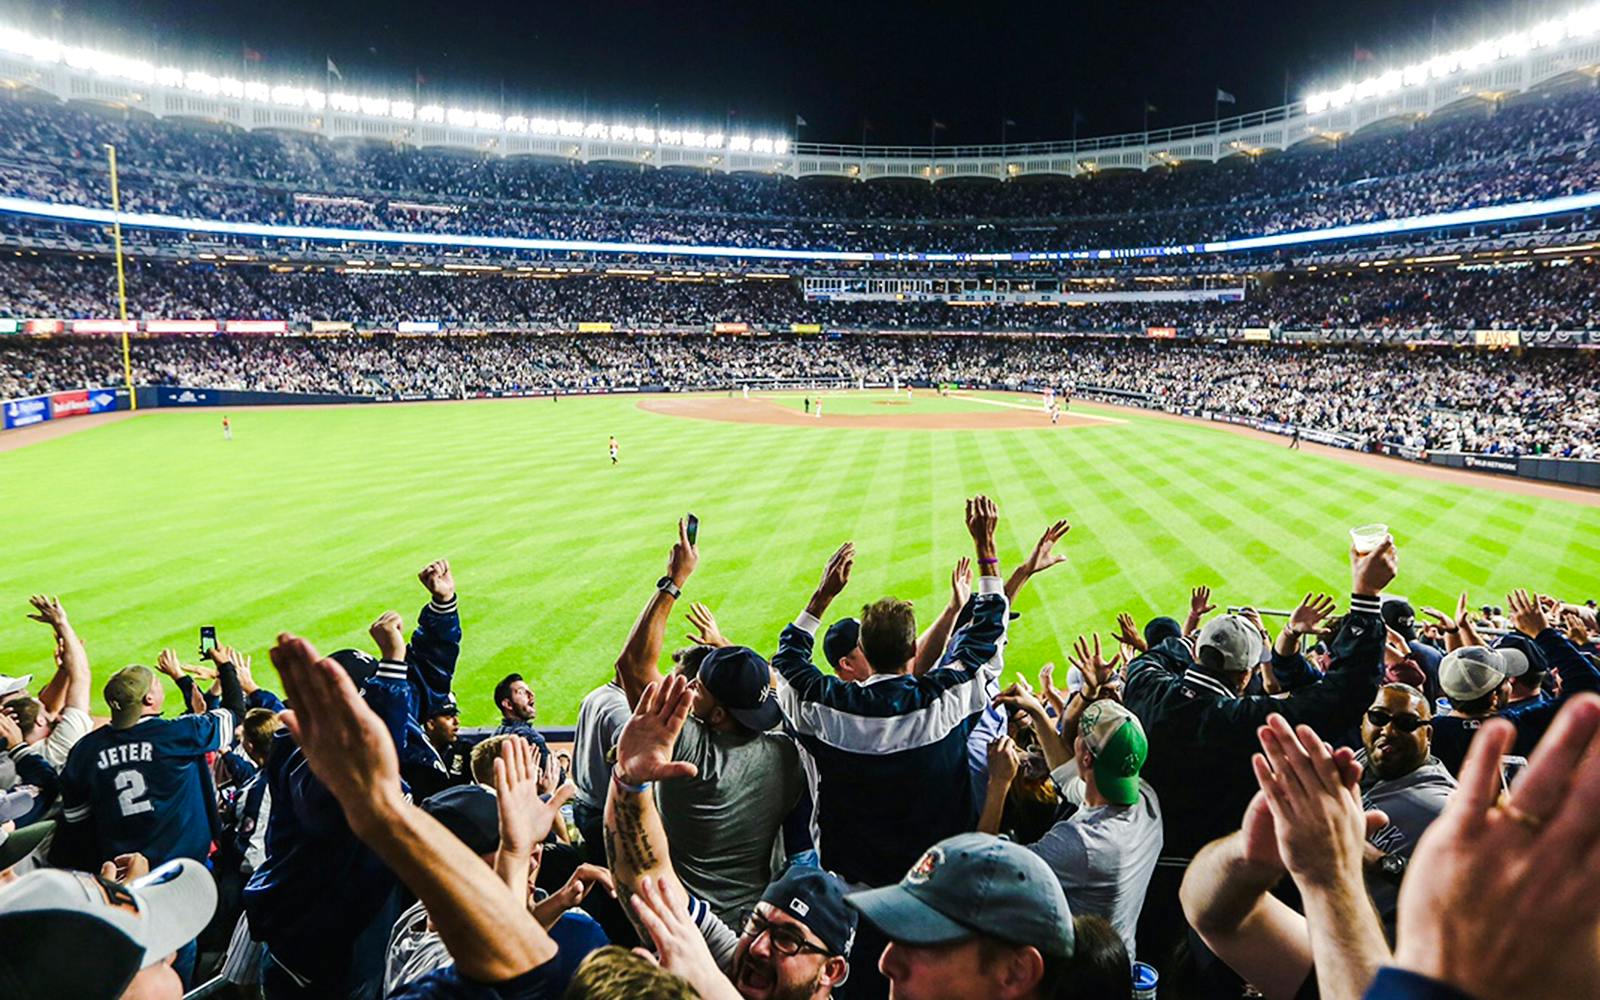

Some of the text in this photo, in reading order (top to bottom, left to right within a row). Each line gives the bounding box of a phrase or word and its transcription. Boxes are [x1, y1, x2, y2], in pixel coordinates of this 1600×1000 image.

[1484, 331, 1511, 344] AVIS
[97, 741, 153, 770] JETER
[114, 769, 153, 816] 2
